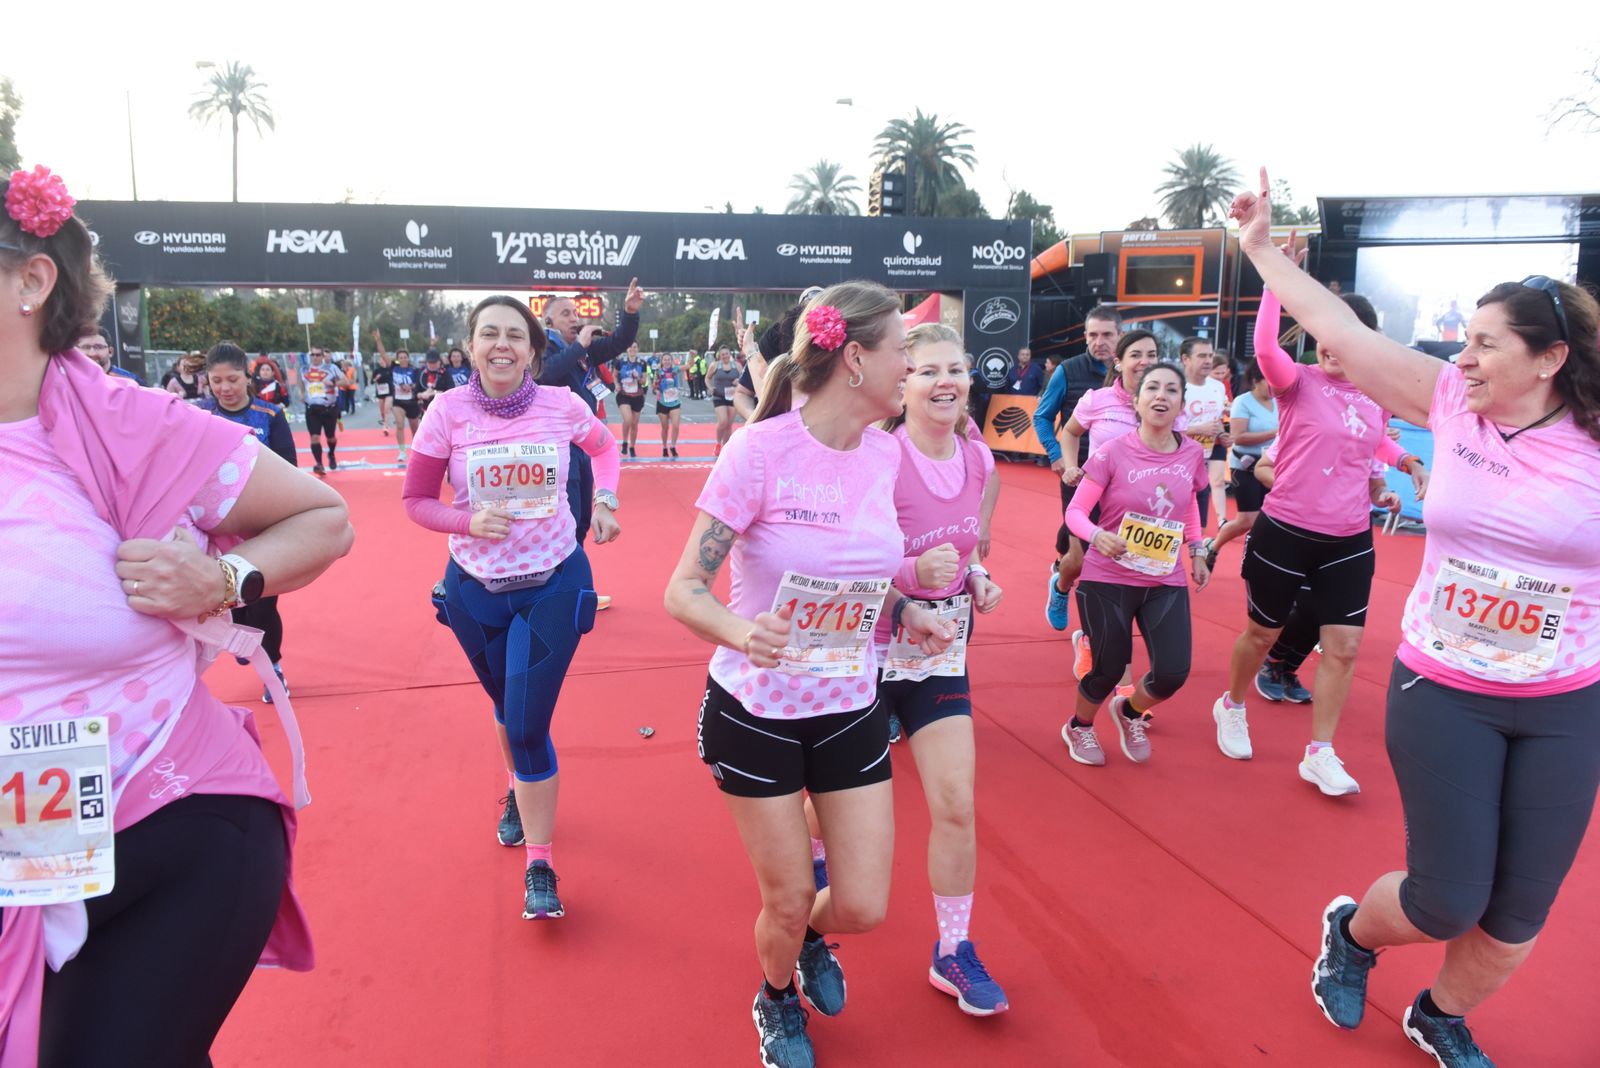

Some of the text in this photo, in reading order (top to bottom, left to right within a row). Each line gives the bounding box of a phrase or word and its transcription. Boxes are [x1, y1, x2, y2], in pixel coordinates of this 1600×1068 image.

[163, 232, 226, 244] HYUNDAI
[204, 245, 226, 253] Motor
[266, 229, 345, 253] HOKA
[520, 230, 618, 249] maratón
[675, 238, 746, 260] HOKA
[545, 243, 619, 266] sevilla
[800, 245, 852, 255] HYUNDAI
[533, 269, 602, 280] 28 enero 2024
[917, 269, 937, 277] Partner
[521, 445, 546, 455] SEVILLA
[475, 463, 545, 488] 13709
[1125, 525, 1174, 551] 10067
[789, 575, 878, 593] MEDIO MARATÓN SEVILLA
[1467, 563, 1499, 581] MARATÓN
[1516, 575, 1556, 594] SEVILLA
[785, 598, 864, 631] 13713
[1443, 582, 1544, 635] 13705
[10, 721, 78, 750] SEVILLA
